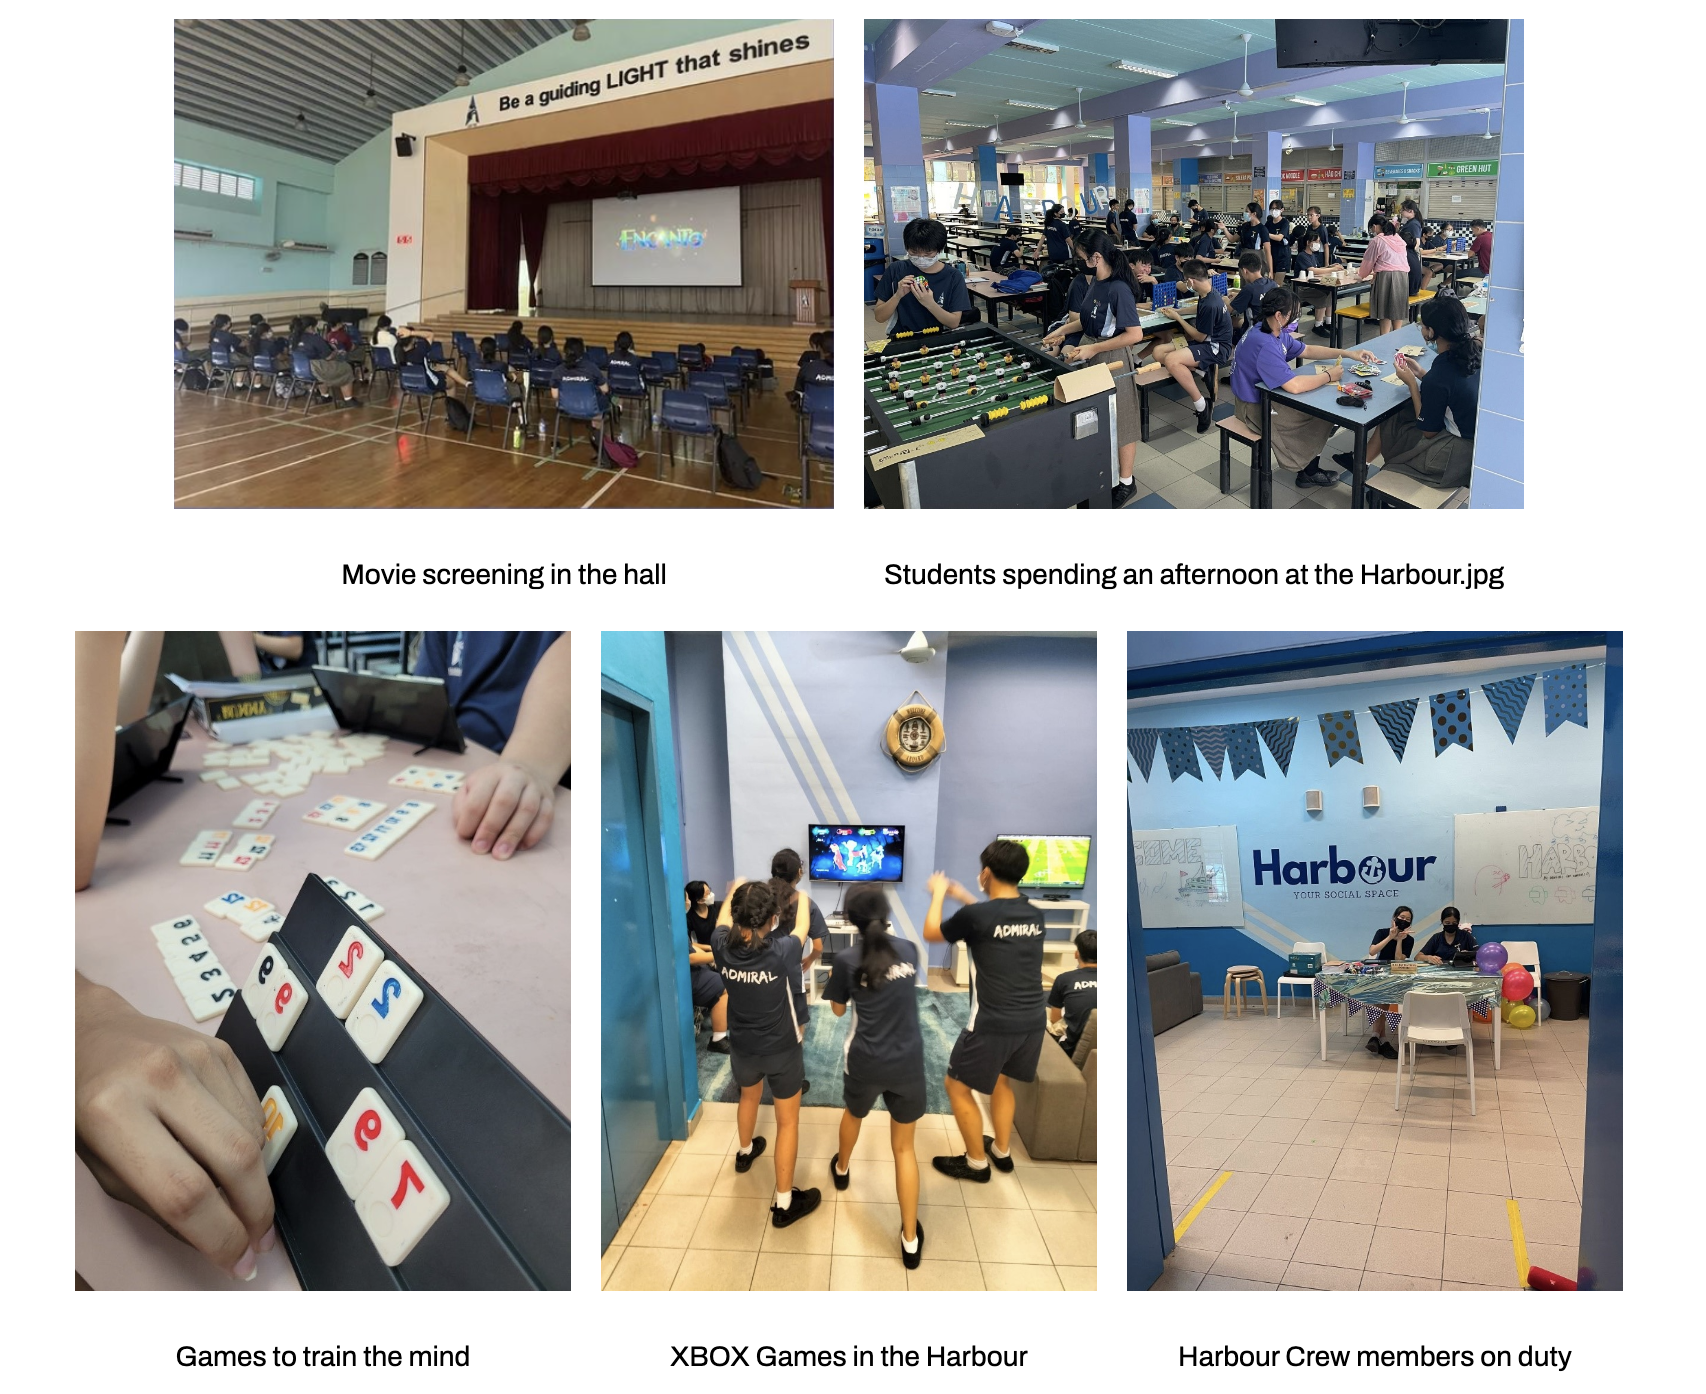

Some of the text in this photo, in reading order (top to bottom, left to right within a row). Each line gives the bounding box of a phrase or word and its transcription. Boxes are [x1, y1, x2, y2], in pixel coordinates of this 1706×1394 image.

[499, 34, 810, 111] Be a guiding LIGHT that shines
[1456, 164, 1492, 174] GREEN HUT
[620, 229, 703, 250] ENCANTO
[1253, 845, 1437, 885] Harbour
[1293, 889, 1399, 900] YOUR SOCIAL SPACE
[994, 924, 1042, 938] ADMIRAL
[721, 965, 778, 985] ADMIRAL
[1074, 980, 1097, 990] ADM
